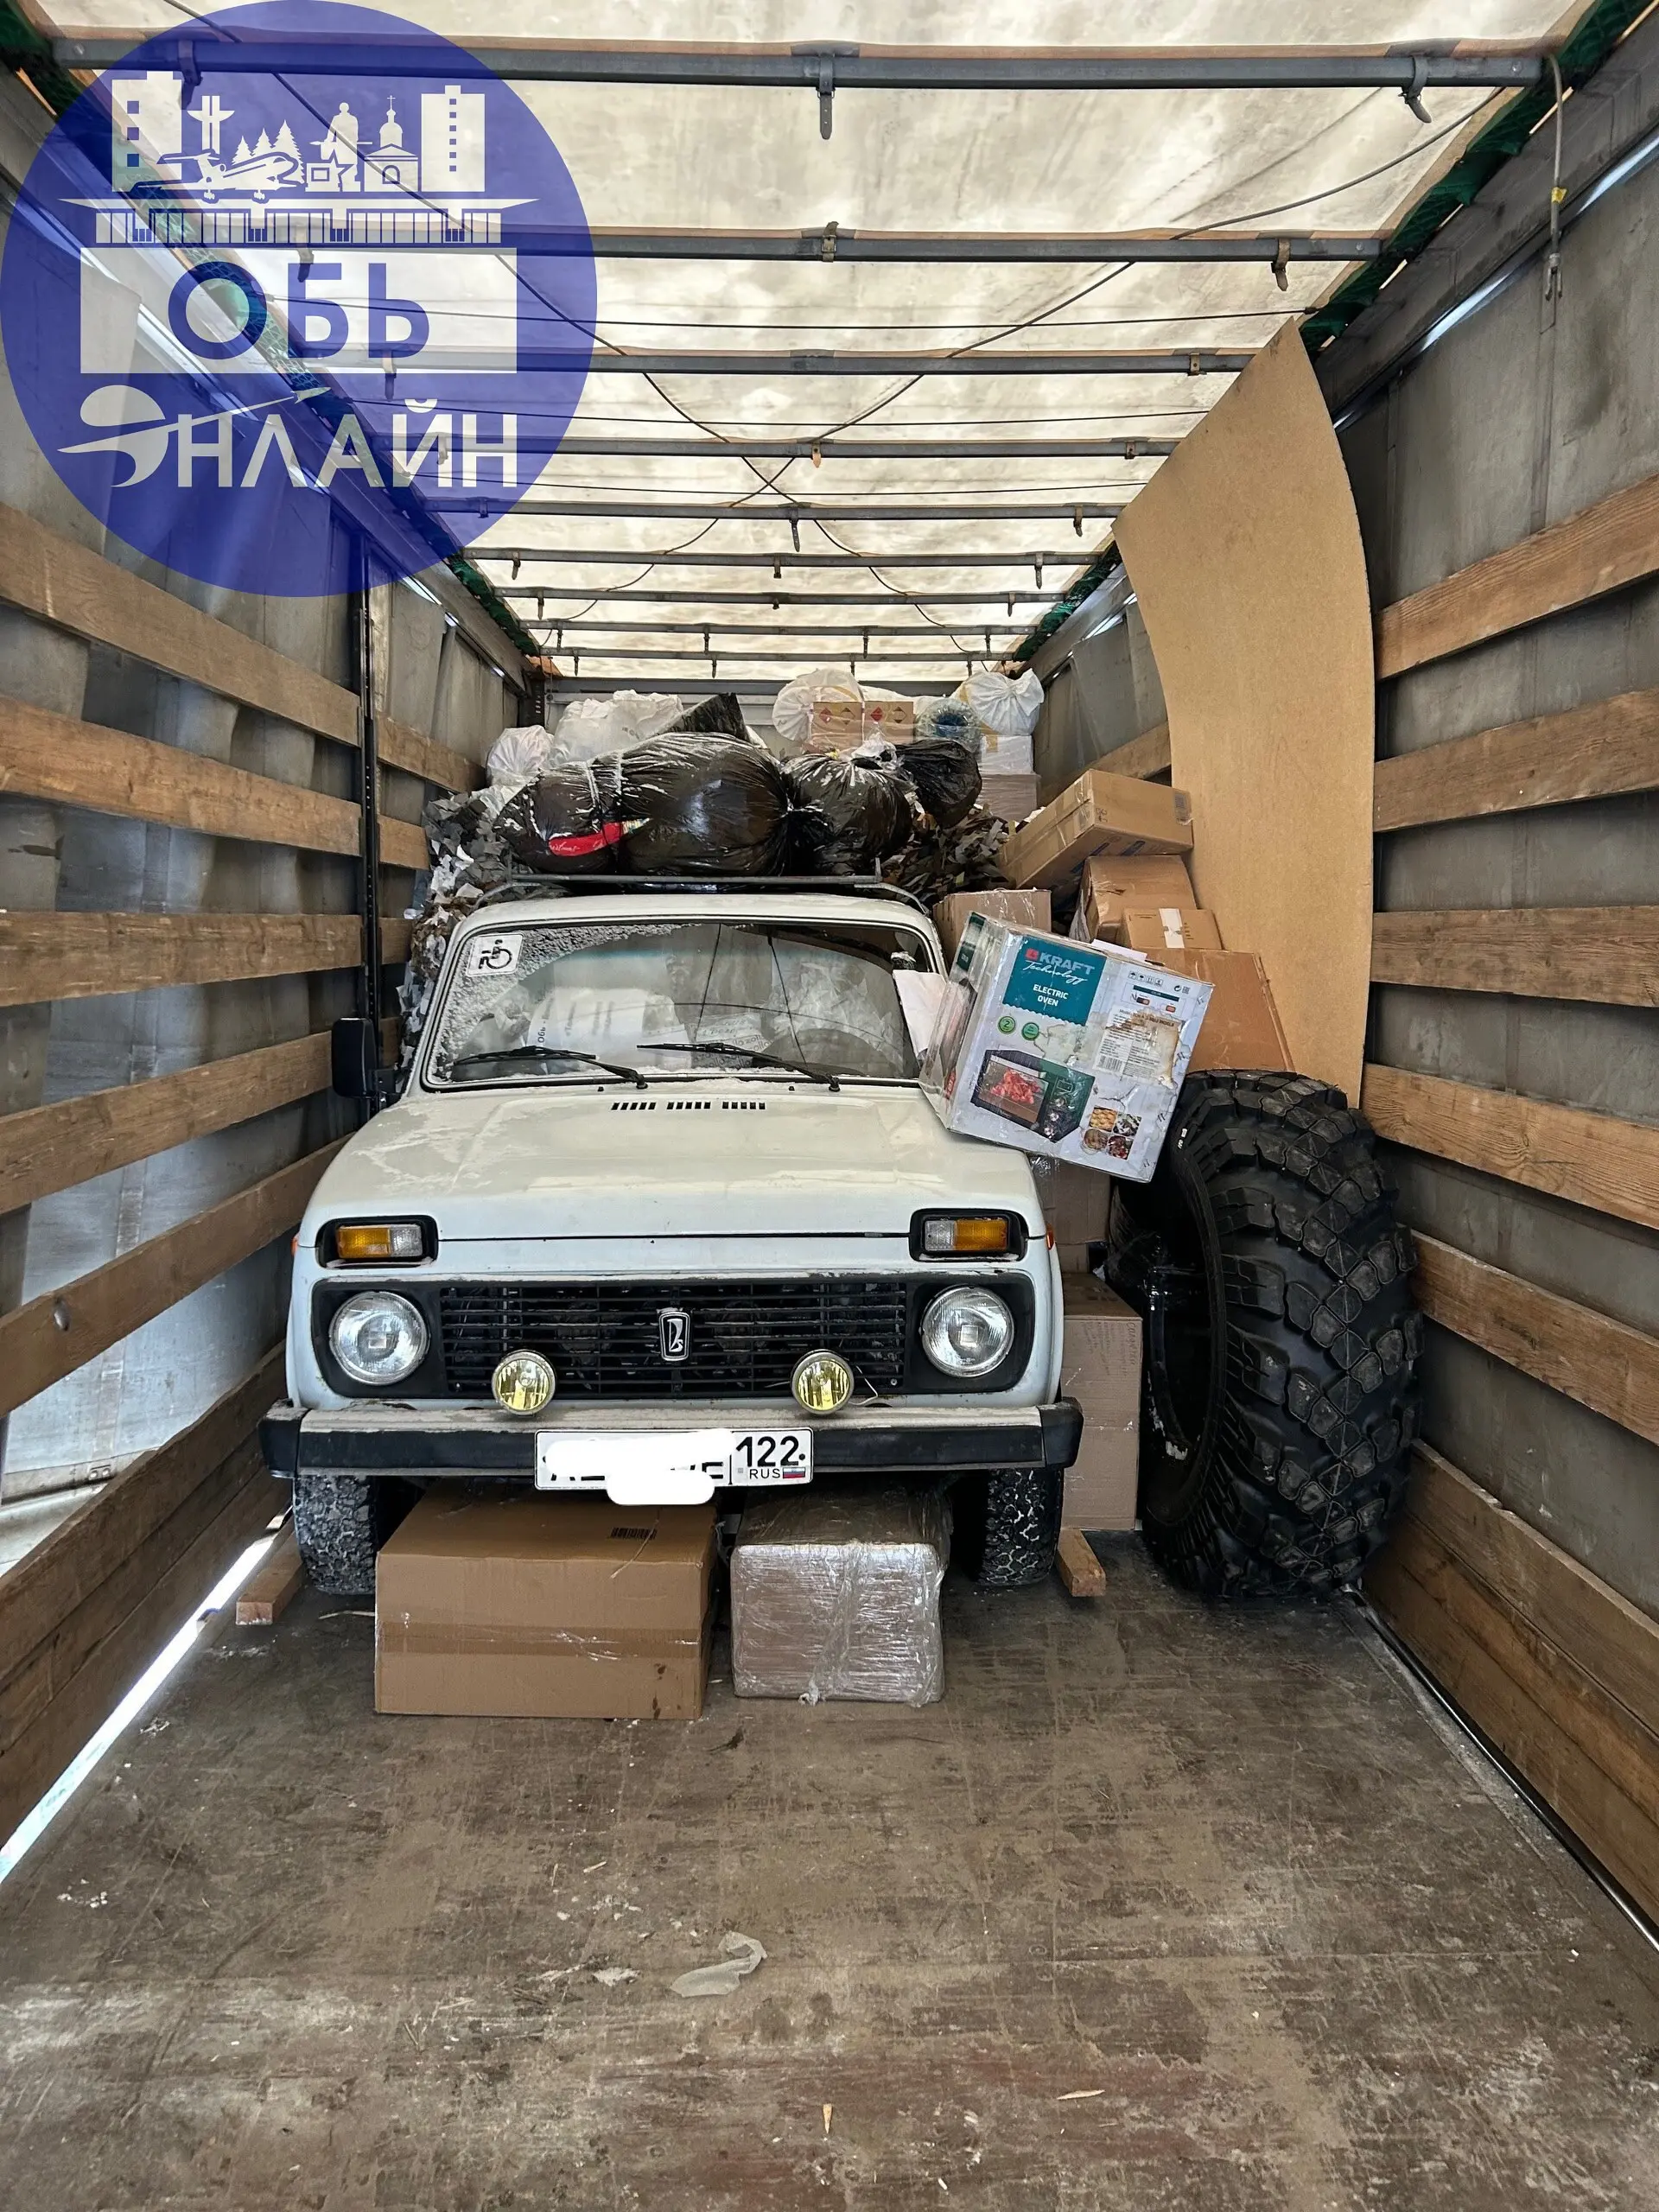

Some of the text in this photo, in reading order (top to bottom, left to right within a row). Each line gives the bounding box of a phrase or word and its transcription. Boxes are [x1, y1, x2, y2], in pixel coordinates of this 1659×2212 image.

[1023, 960, 1088, 985] Technology
[1039, 951, 1095, 975] KRAFT
[1033, 984, 1070, 1000] ELECTRIC
[1038, 995, 1059, 1007] OVEN
[736, 1436, 800, 1467] 122
[749, 1468, 781, 1479] RUS
